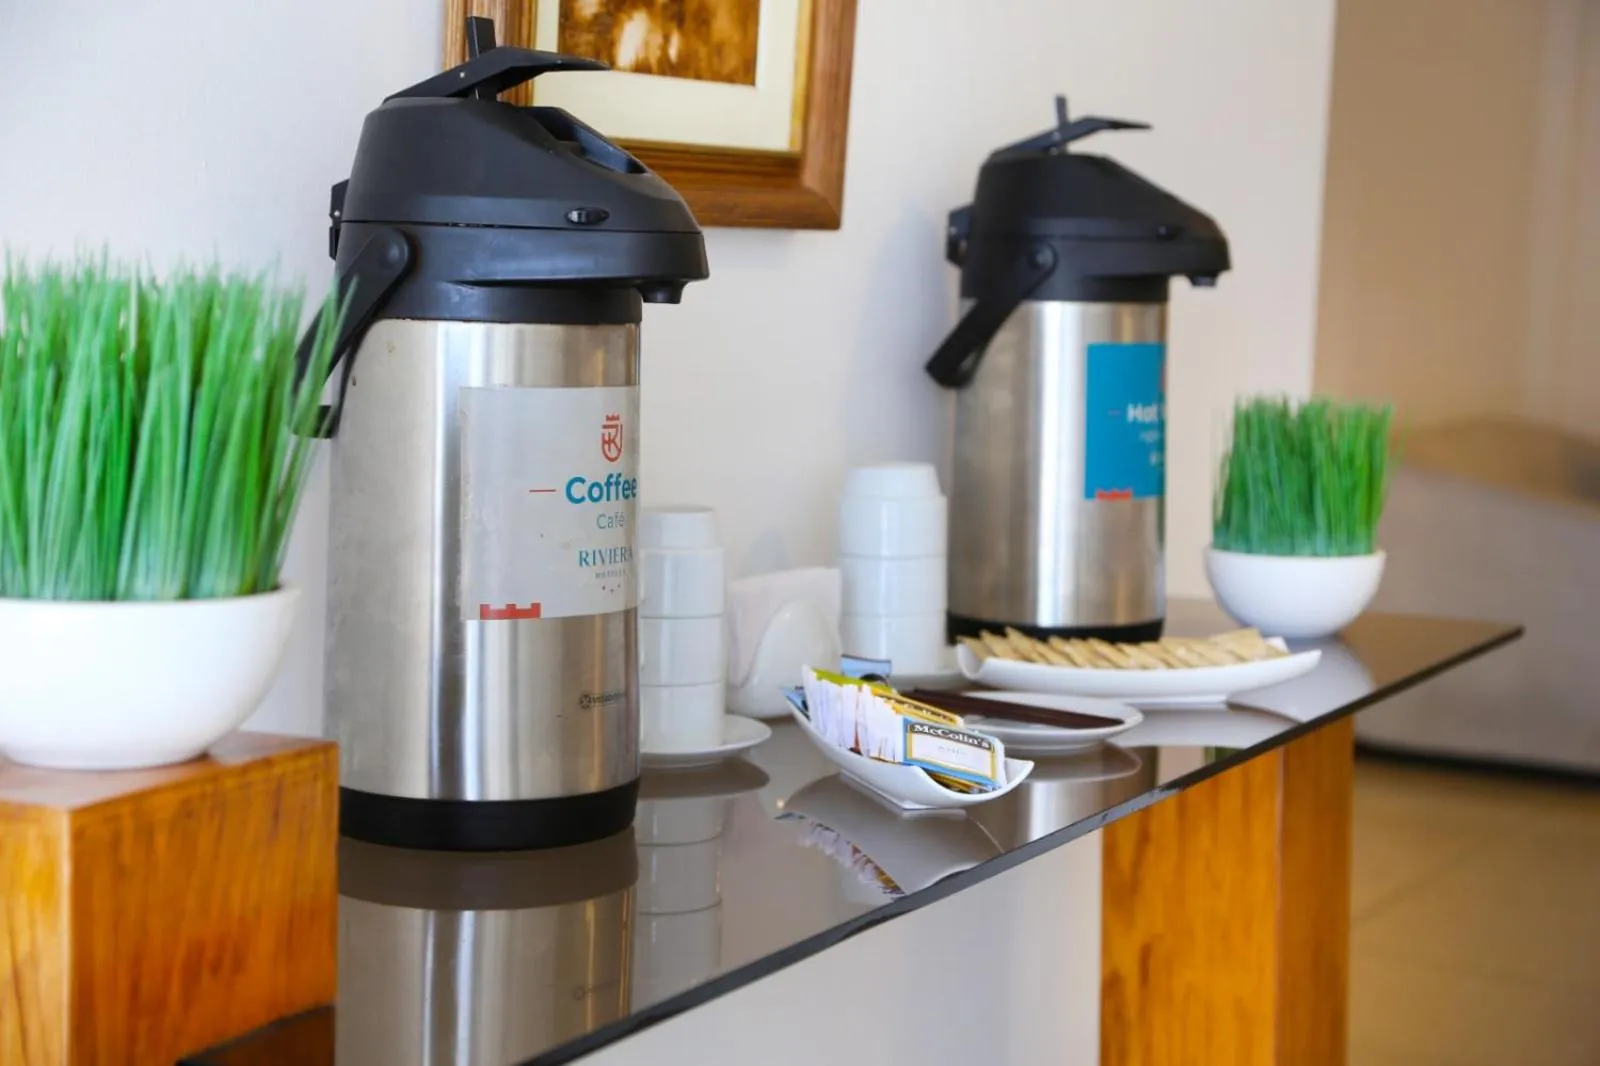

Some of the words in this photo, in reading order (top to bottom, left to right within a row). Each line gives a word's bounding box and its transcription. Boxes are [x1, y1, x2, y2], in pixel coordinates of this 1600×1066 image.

[565, 472, 638, 504] Coffee
[596, 511, 625, 530] Café
[913, 723, 990, 749] McColin's
